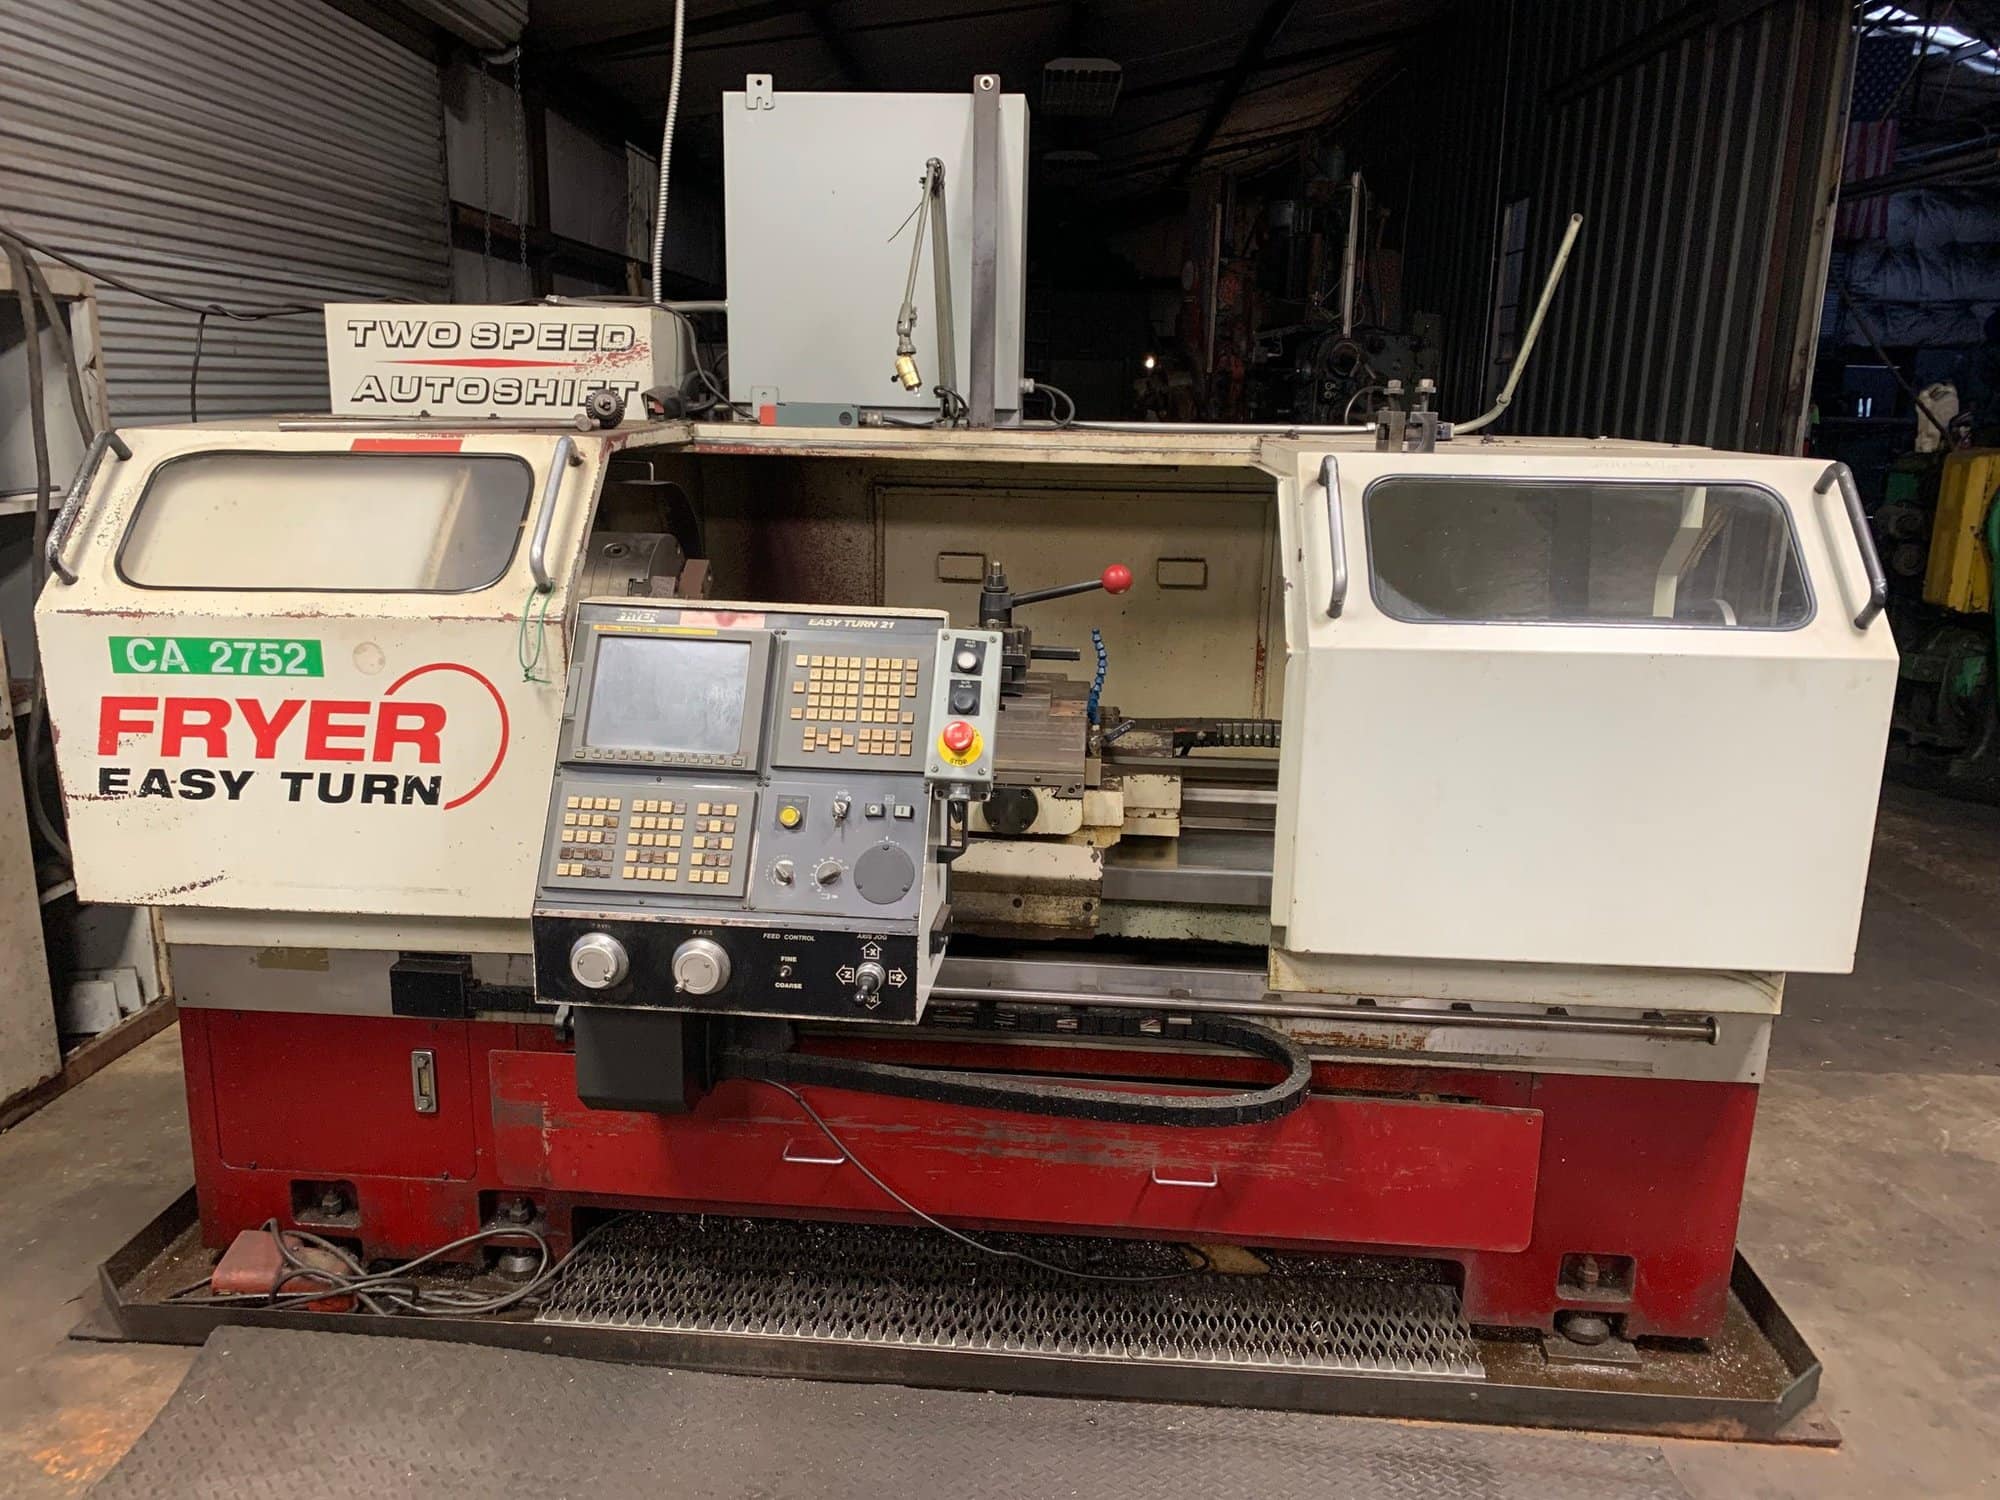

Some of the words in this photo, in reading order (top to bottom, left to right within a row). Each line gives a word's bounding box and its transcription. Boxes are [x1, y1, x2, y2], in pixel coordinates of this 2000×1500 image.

[347, 320, 462, 349] TWO
[470, 321, 636, 352] SPEED
[807, 618, 842, 627] EASY
[845, 620, 878, 629] TURN
[879, 621, 895, 629] 21
[125, 638, 189, 672] CA
[209, 641, 308, 675] 2752
[97, 695, 448, 764] FRYER
[98, 767, 255, 800] EASY
[280, 771, 442, 806] TURN
[762, 932, 781, 940] FEED
[783, 934, 816, 942] CONTROL
[866, 948, 877, 956] -X
[780, 955, 798, 963] FINE
[840, 970, 852, 979] -Z
[890, 973, 902, 982] +Z
[774, 982, 803, 990] COARSE
